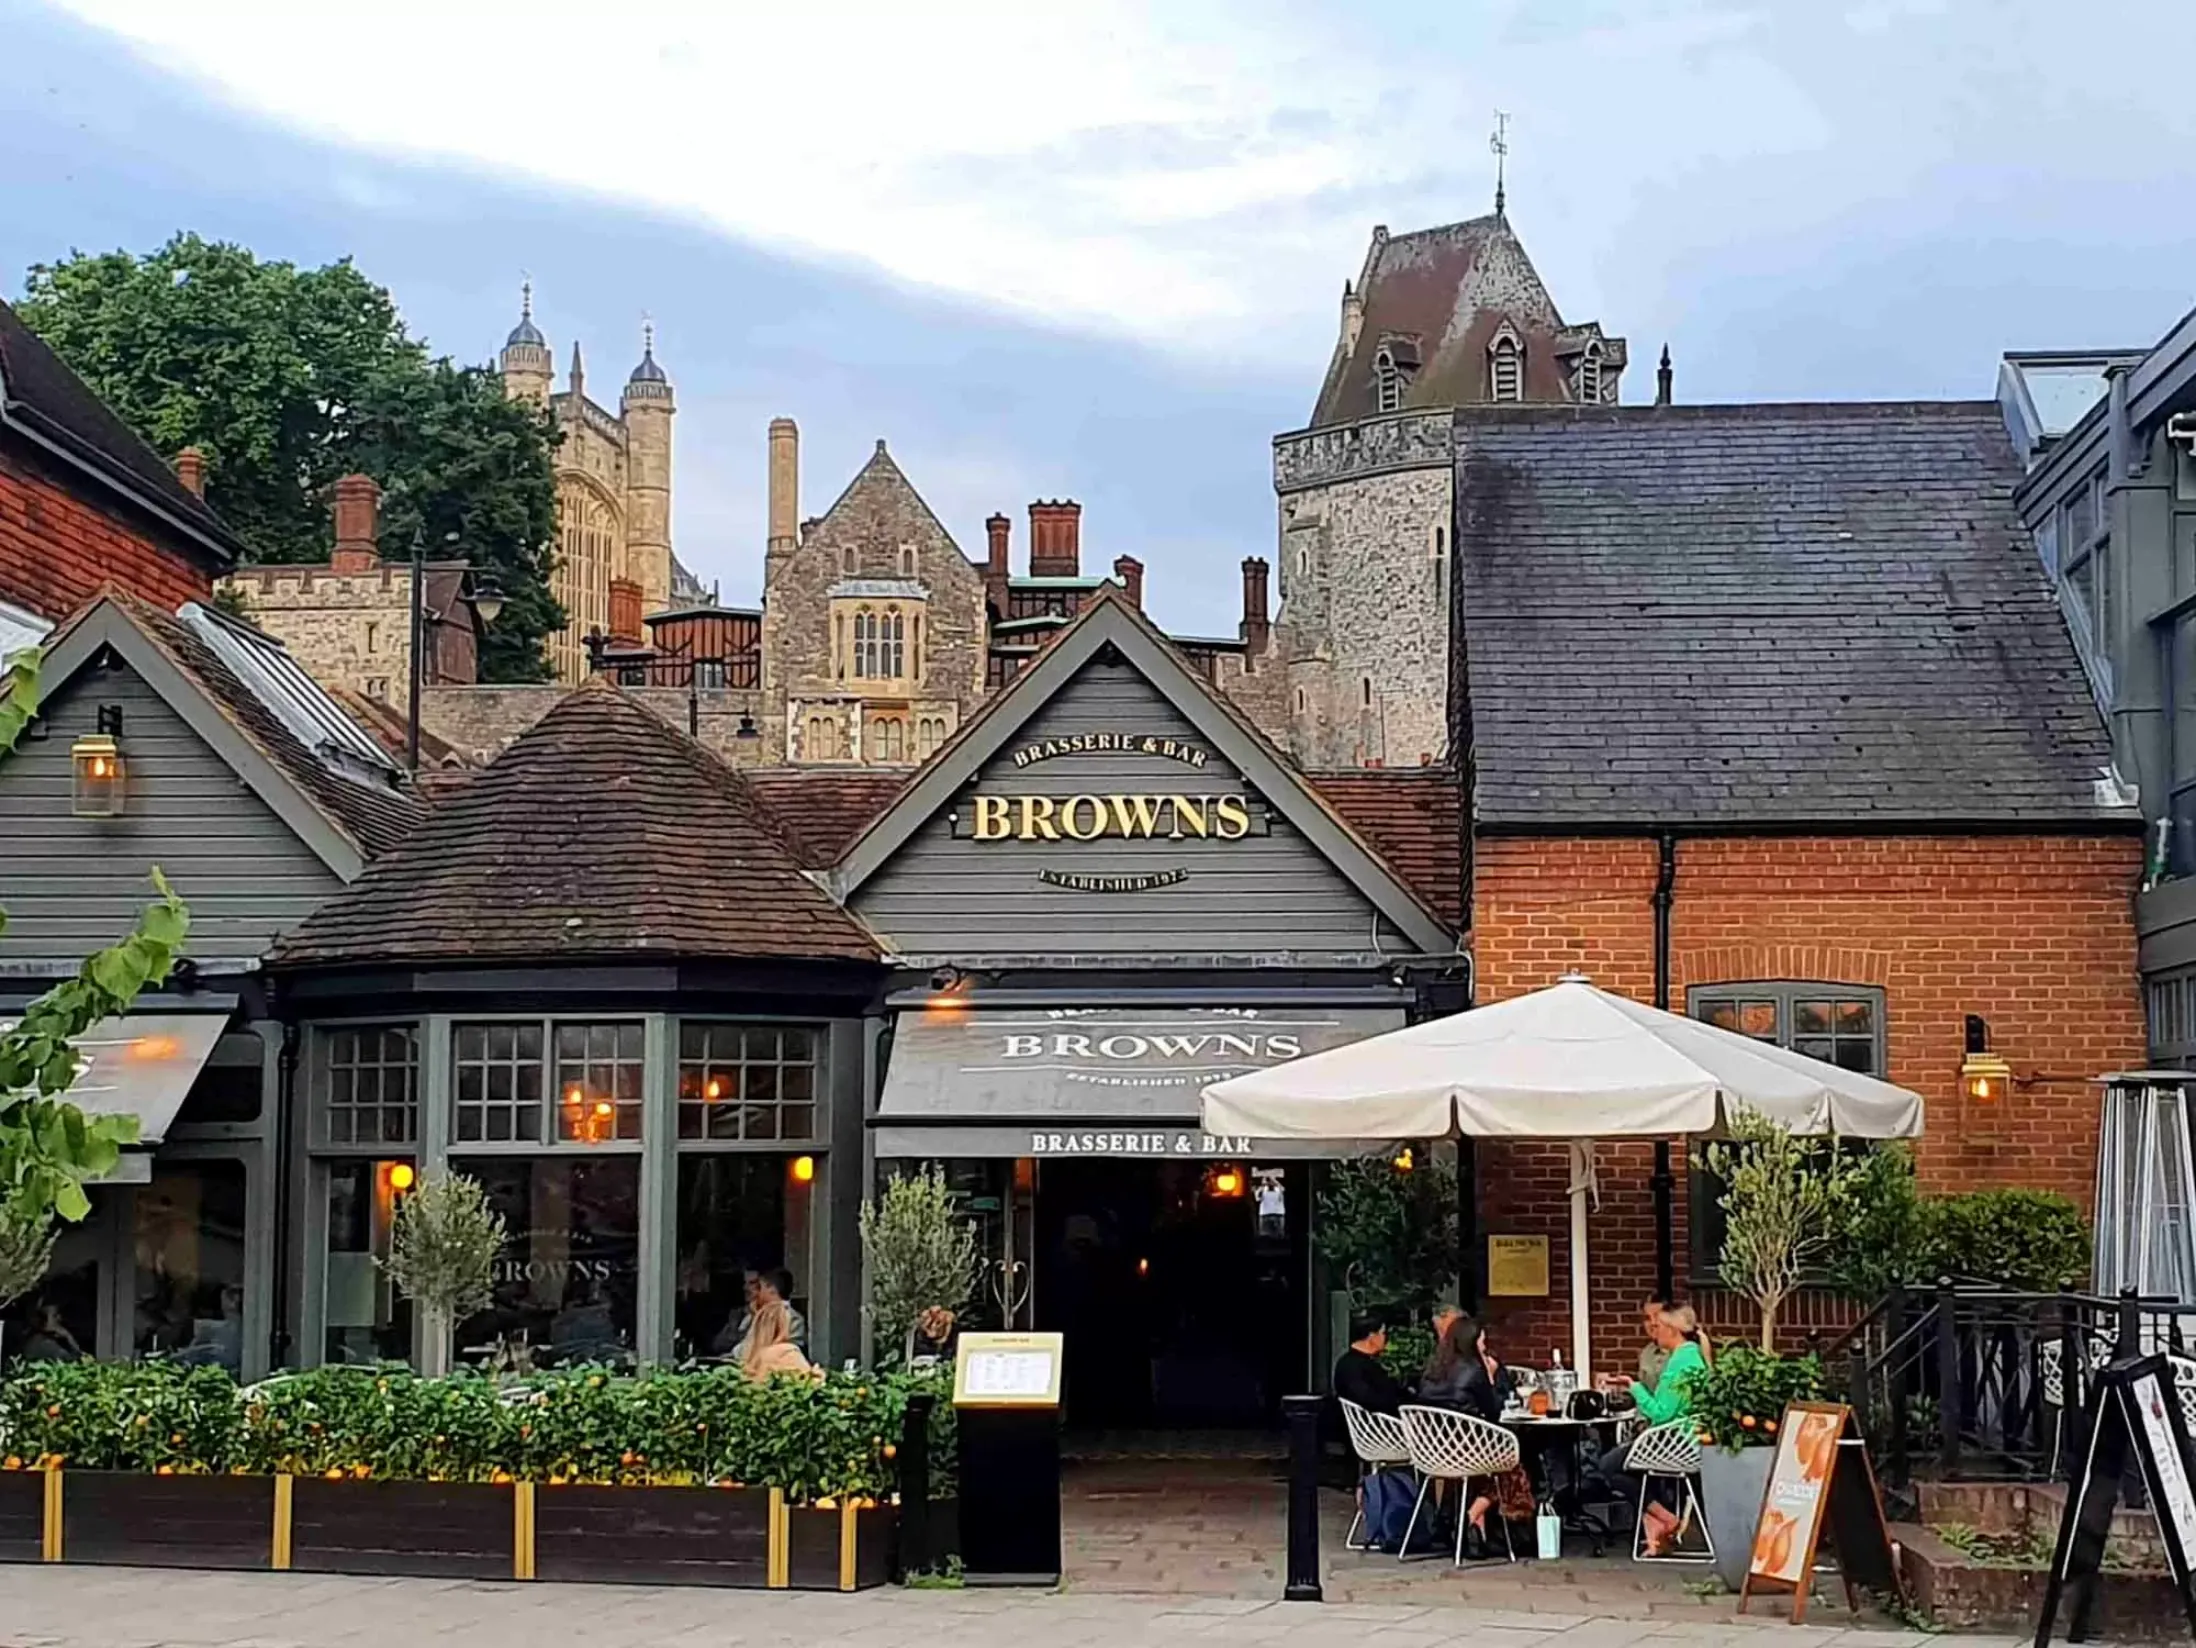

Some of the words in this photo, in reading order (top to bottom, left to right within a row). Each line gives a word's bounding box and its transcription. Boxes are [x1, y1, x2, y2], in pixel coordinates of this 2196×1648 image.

[1013, 734, 1135, 768] BRASSERIE
[1142, 736, 1158, 753] &
[1162, 739, 1207, 768] BAR
[972, 794, 1250, 840] BROWNS
[1001, 1034, 1301, 1058] BROWNS
[1032, 1133, 1165, 1152] BRASSERIE
[1174, 1134, 1192, 1153] &
[1202, 1135, 1252, 1154] BAR
